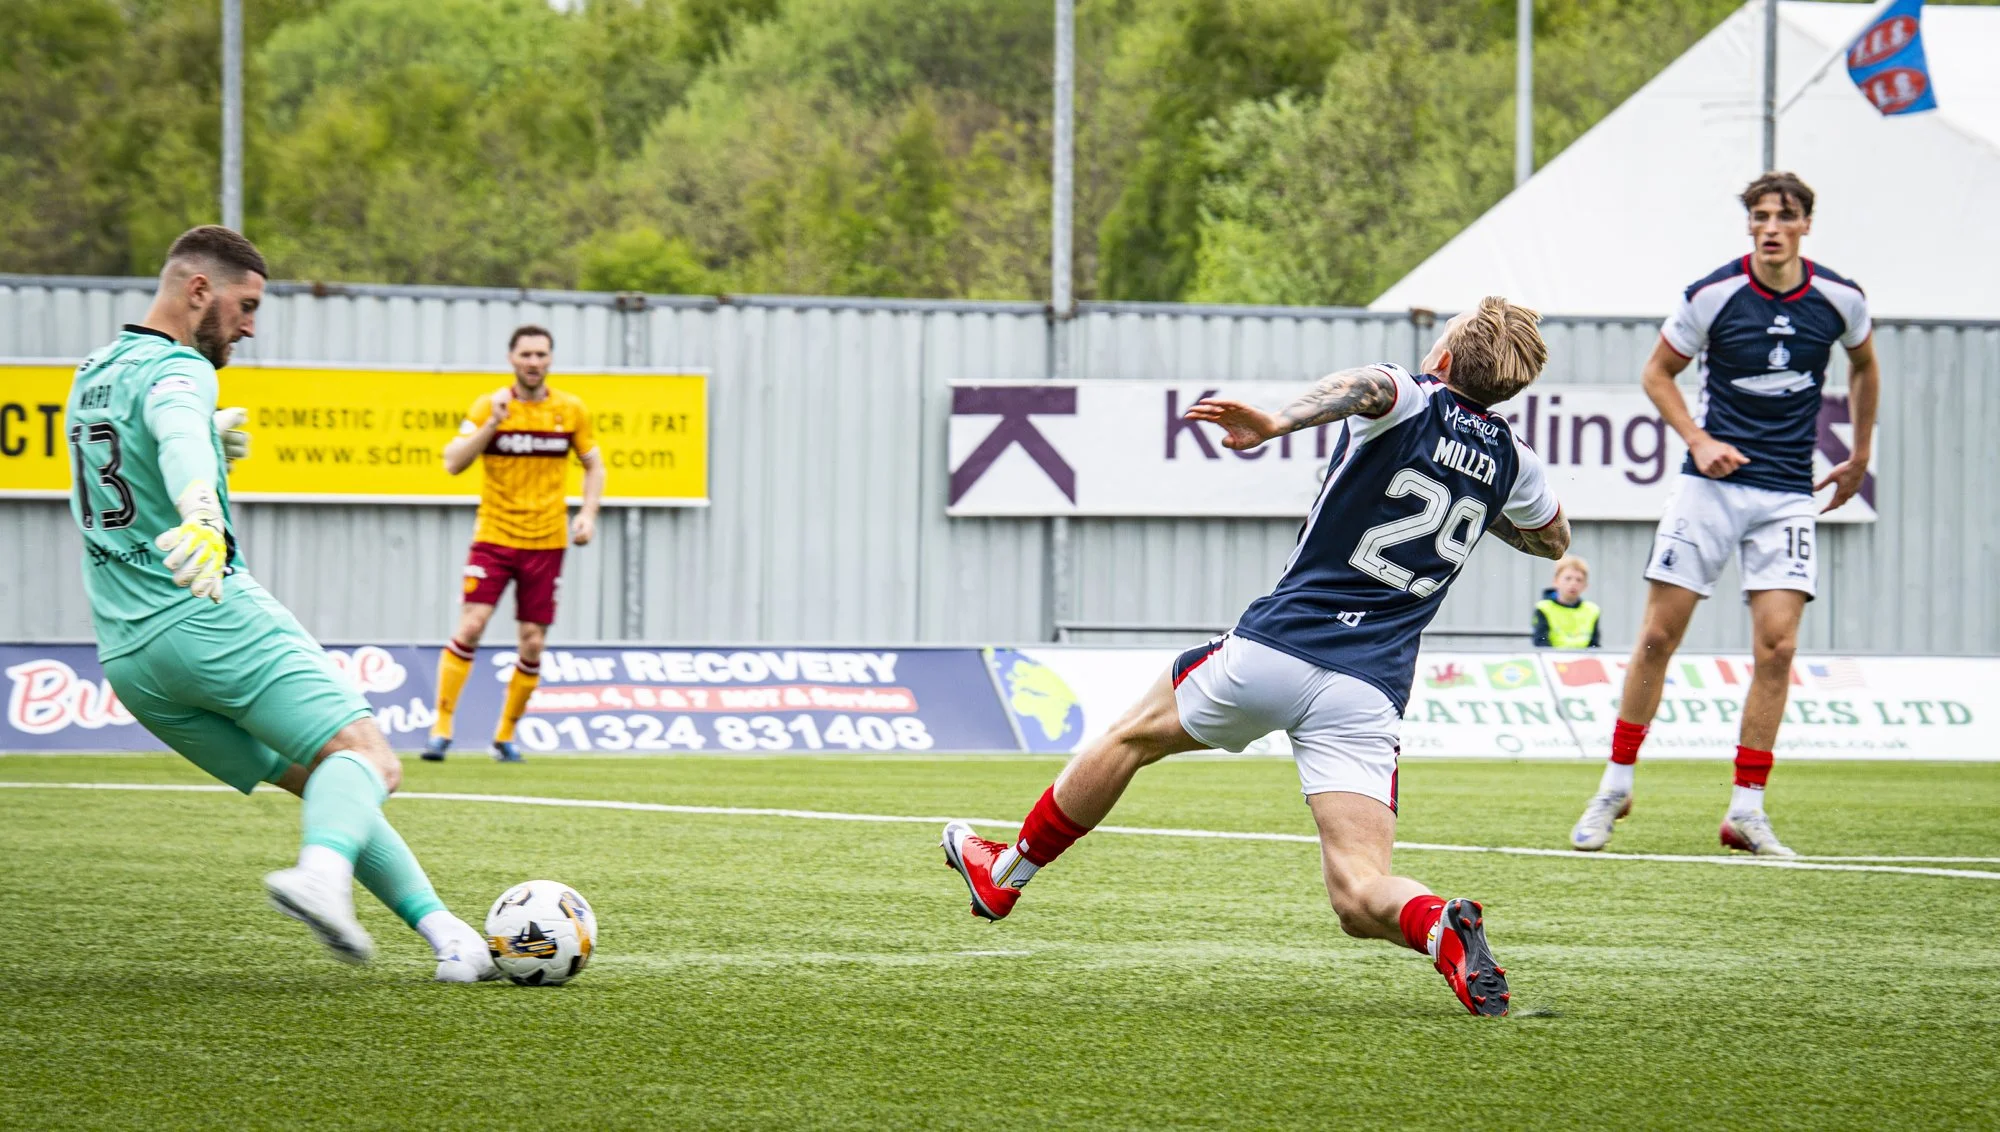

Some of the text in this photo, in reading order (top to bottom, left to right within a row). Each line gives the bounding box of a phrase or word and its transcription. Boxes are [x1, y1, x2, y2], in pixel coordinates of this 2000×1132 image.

[258, 406, 376, 429] DOMESTIC
[651, 414, 689, 433] PAT
[69, 421, 137, 531] 13
[1432, 436, 1496, 486] MILLER
[1349, 468, 1487, 598] 29
[1784, 526, 1810, 560] 16
[621, 652, 899, 683] RECOVERY
[1873, 701, 1974, 726] LTD
[517, 714, 935, 751] 01324 831408
